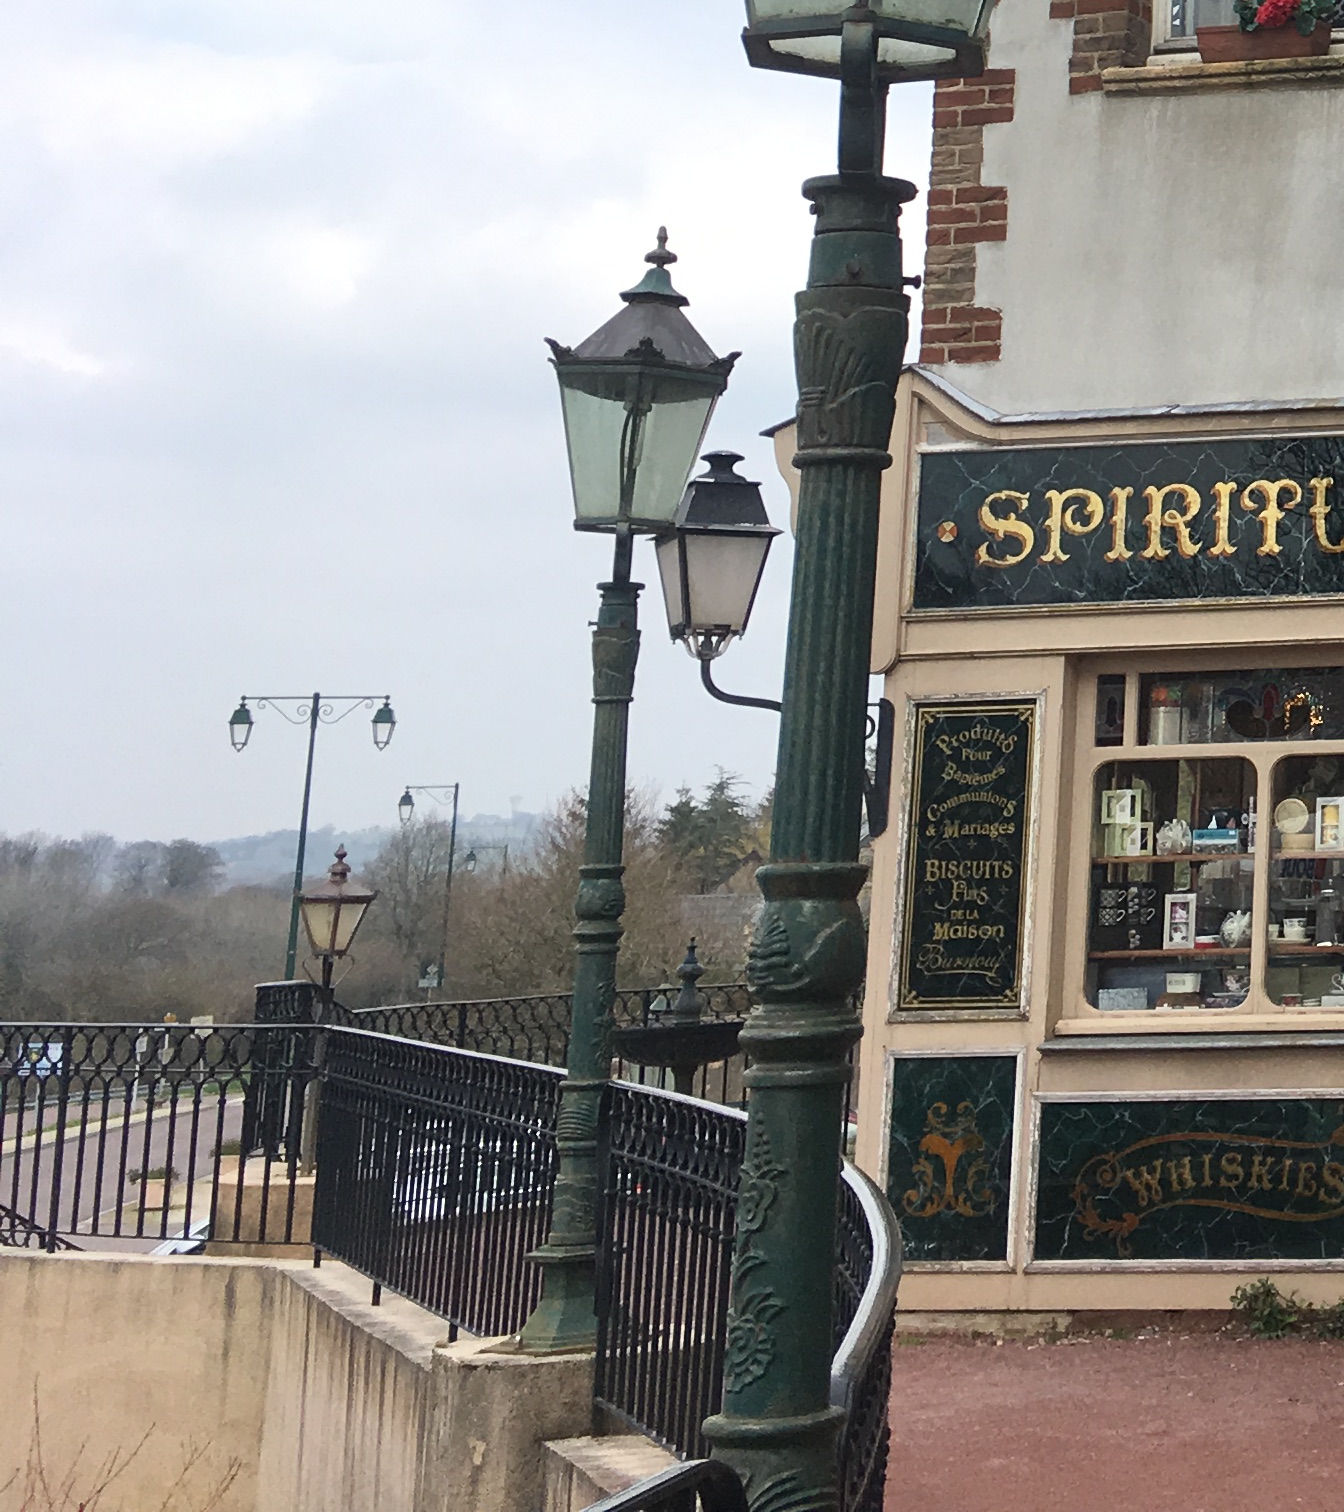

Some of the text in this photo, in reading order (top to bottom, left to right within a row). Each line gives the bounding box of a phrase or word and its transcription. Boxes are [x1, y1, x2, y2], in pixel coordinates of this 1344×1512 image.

[936, 723, 1018, 755] Produits
[926, 789, 1017, 822] Communions
[925, 818, 1016, 840] & Mariages
[924, 859, 1014, 882] BISCUITS
[950, 909, 980, 920] DE LA
[932, 921, 1005, 941] Maison
